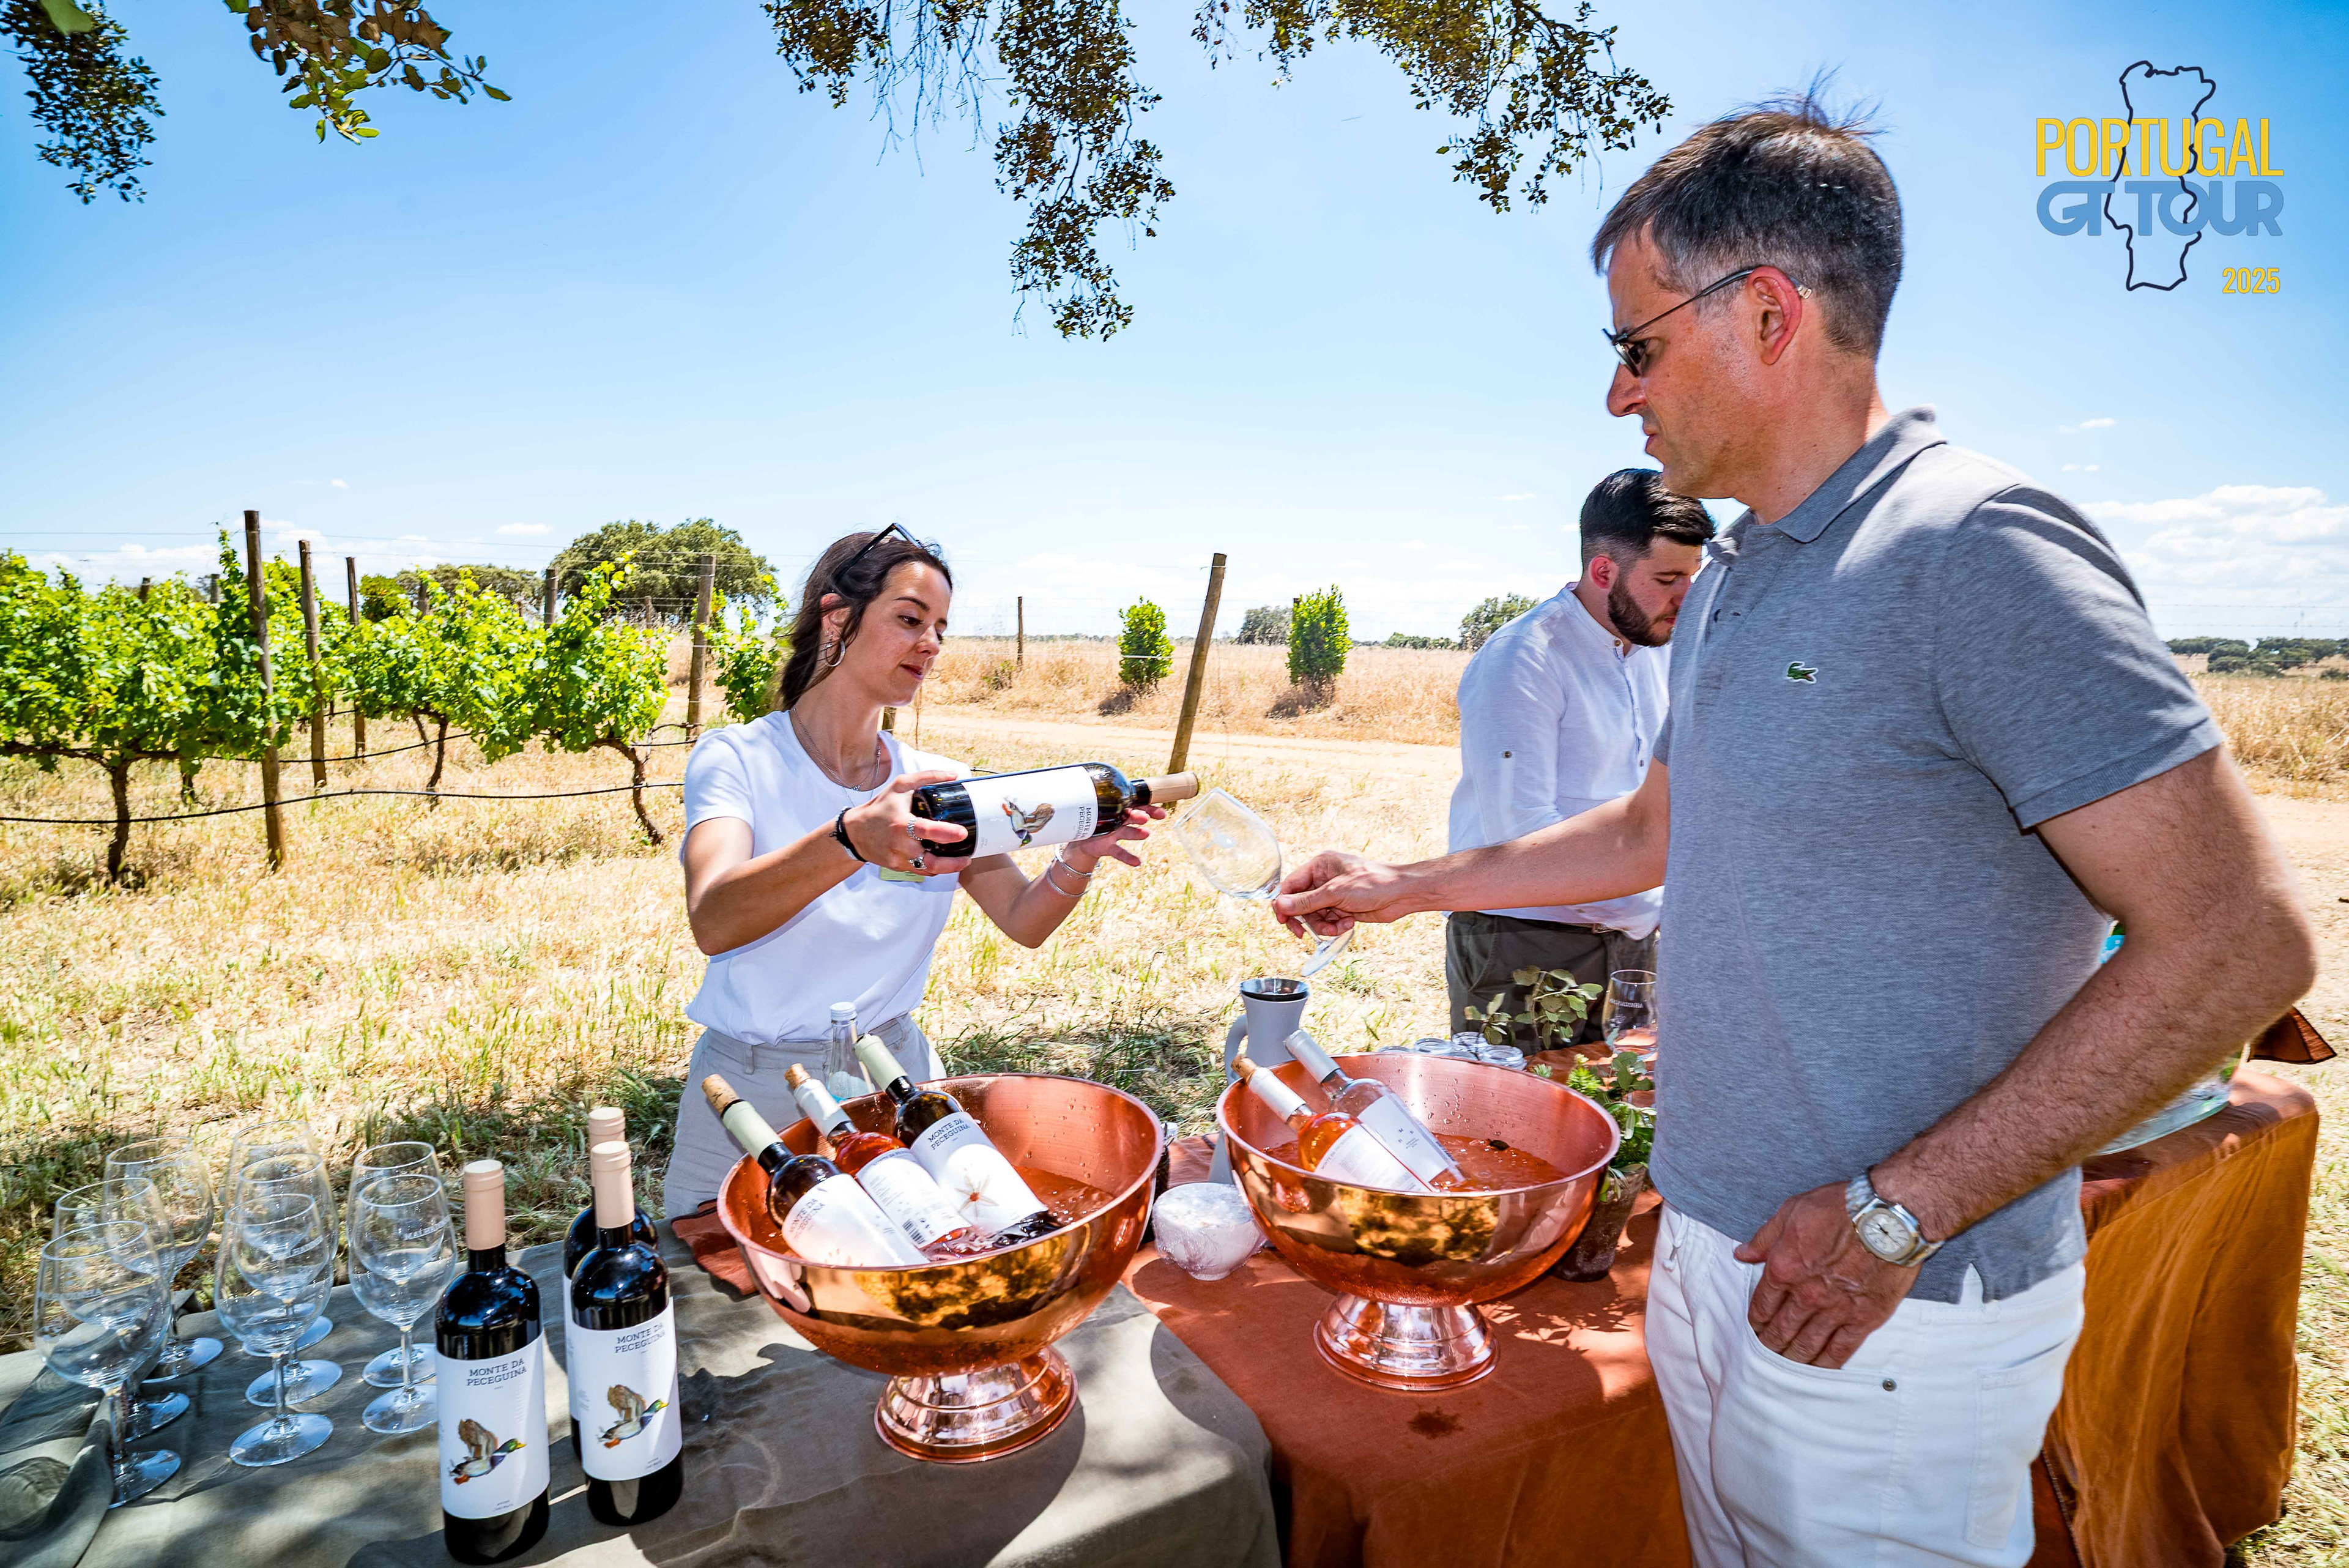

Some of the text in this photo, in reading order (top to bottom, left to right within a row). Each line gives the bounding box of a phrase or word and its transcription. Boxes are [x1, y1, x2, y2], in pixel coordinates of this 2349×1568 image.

[928, 1122, 954, 1142] MONTE
[930, 1124, 970, 1150] PECEGUINA
[616, 1328, 651, 1344] MONTE
[466, 1367, 527, 1386] PECEGUINA
[469, 1358, 525, 1377] MONTE DA
